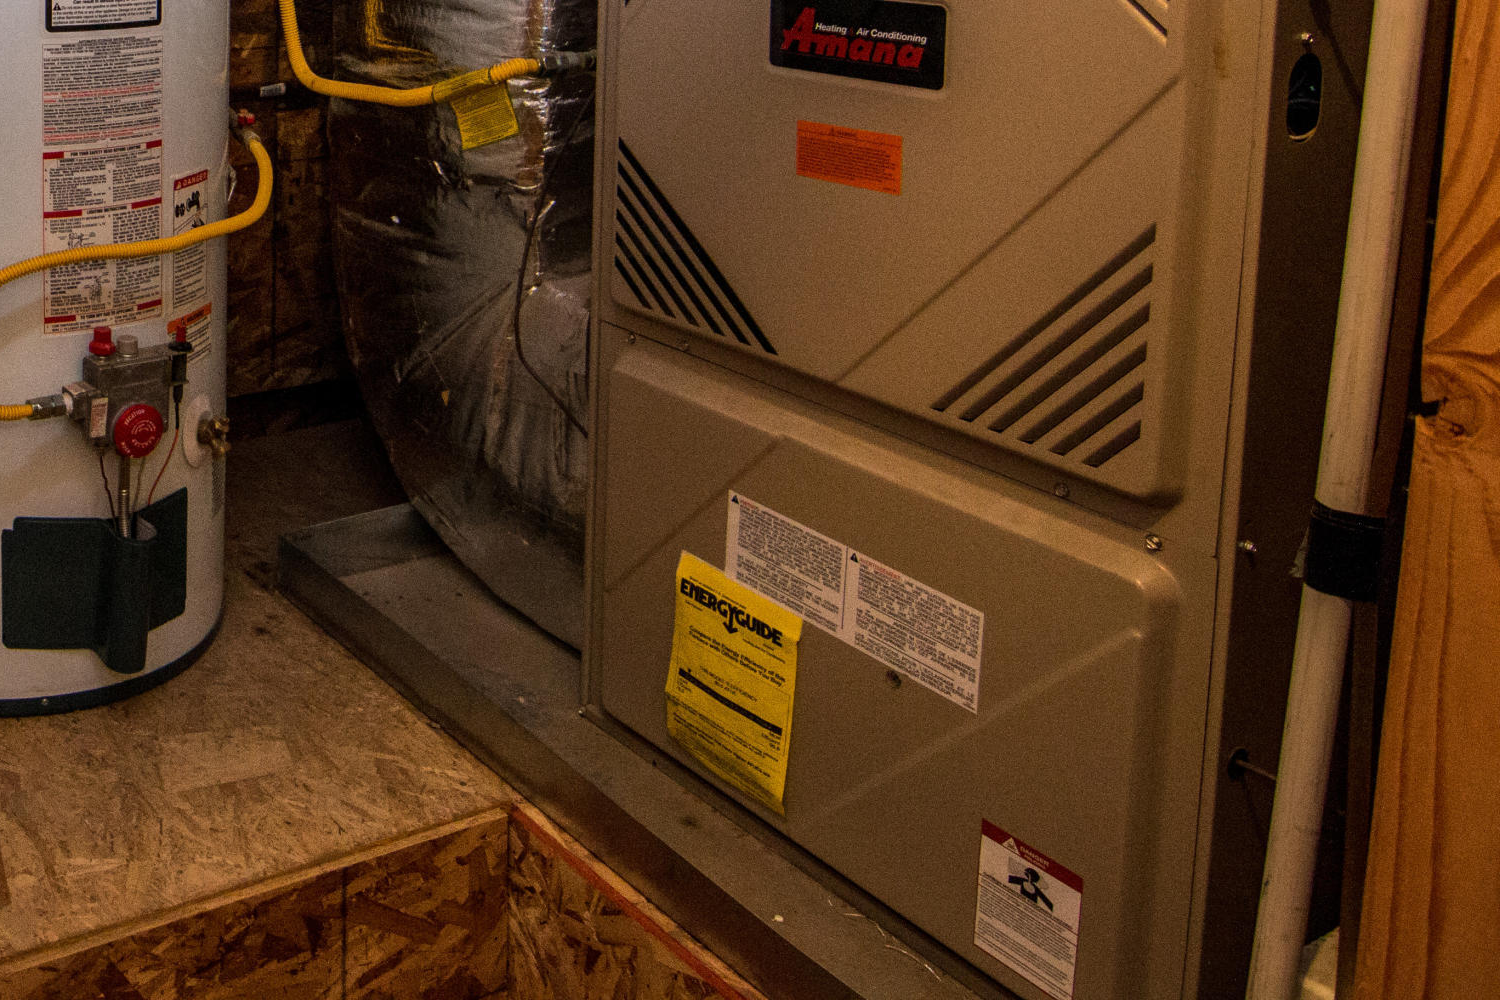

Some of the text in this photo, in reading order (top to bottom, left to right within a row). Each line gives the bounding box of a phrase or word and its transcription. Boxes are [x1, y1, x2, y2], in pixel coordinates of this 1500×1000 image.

[781, 7, 925, 69] Amana
[815, 23, 927, 44] Heating Air Conditioning
[182, 171, 208, 185] DANGER
[680, 578, 783, 647] ENERGYGUIDE
